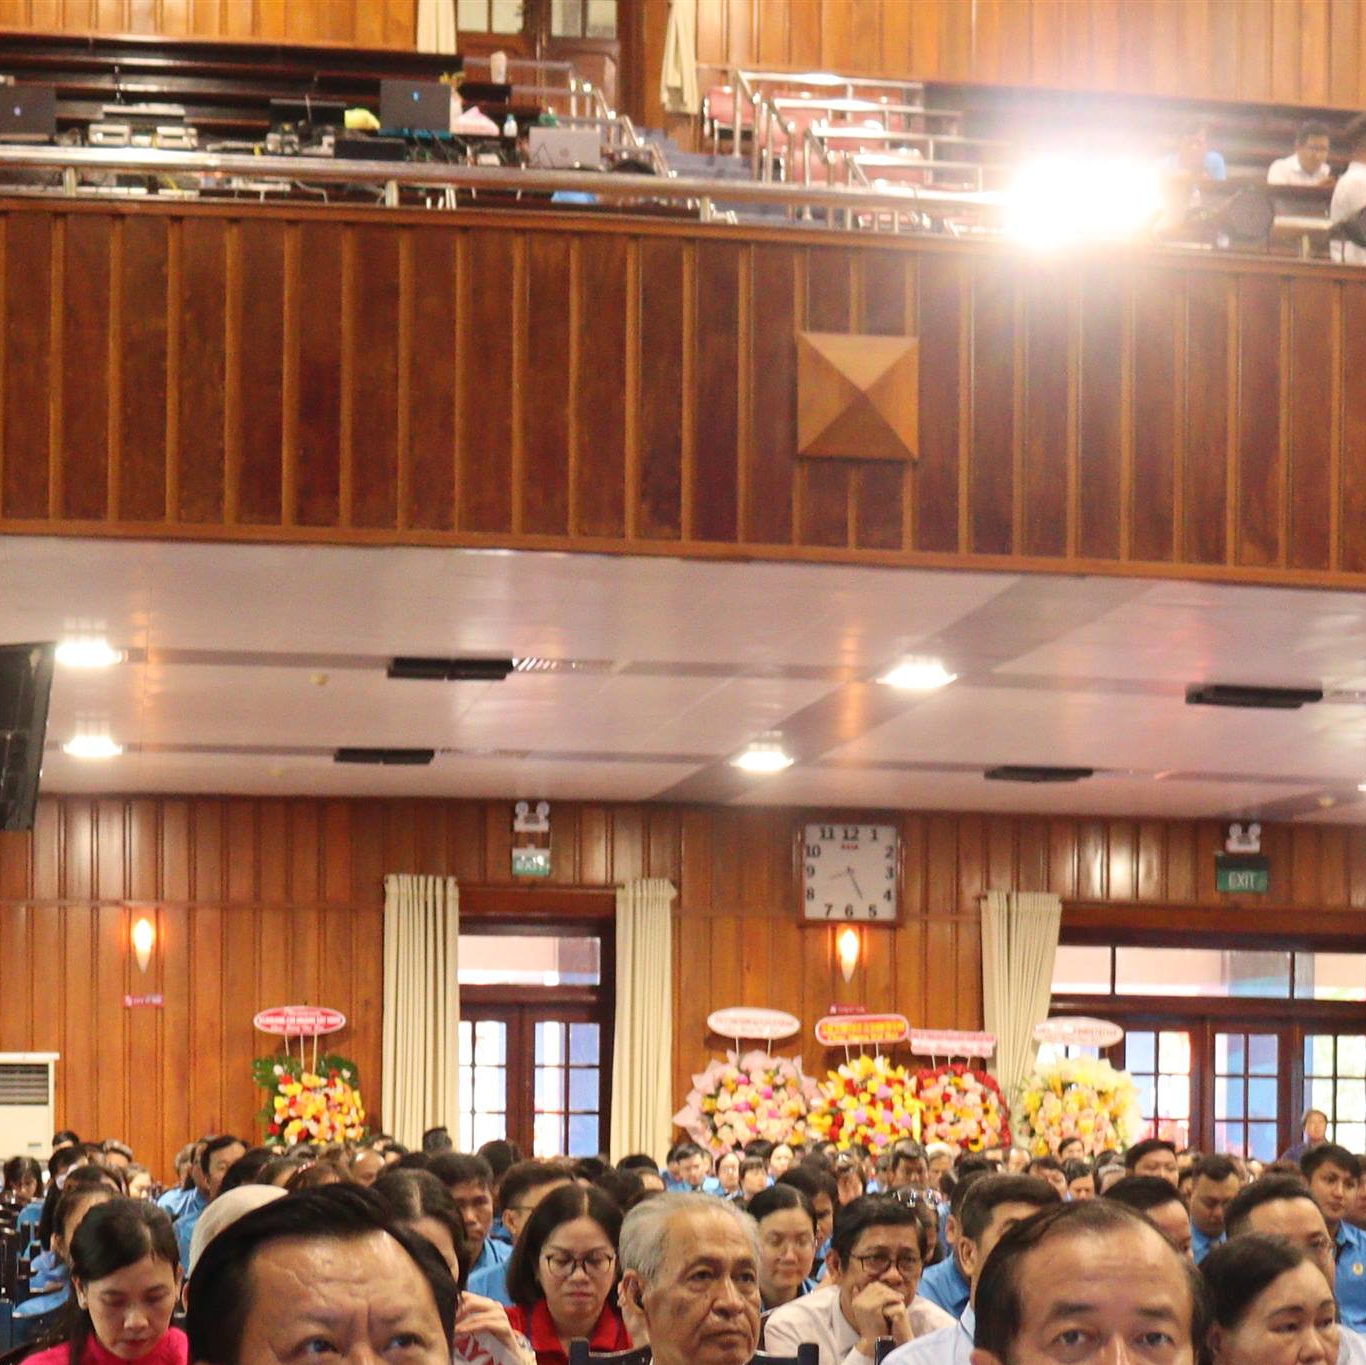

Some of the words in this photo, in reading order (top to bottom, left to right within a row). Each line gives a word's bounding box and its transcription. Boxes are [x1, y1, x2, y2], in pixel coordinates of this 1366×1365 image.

[842, 827, 859, 841] 12
[806, 845, 821, 858] 10
[806, 865, 815, 878] 9
[1228, 871, 1256, 890] EXIT
[806, 887, 815, 900] 8
[883, 889, 892, 901] 4
[845, 904, 853, 918] 6
